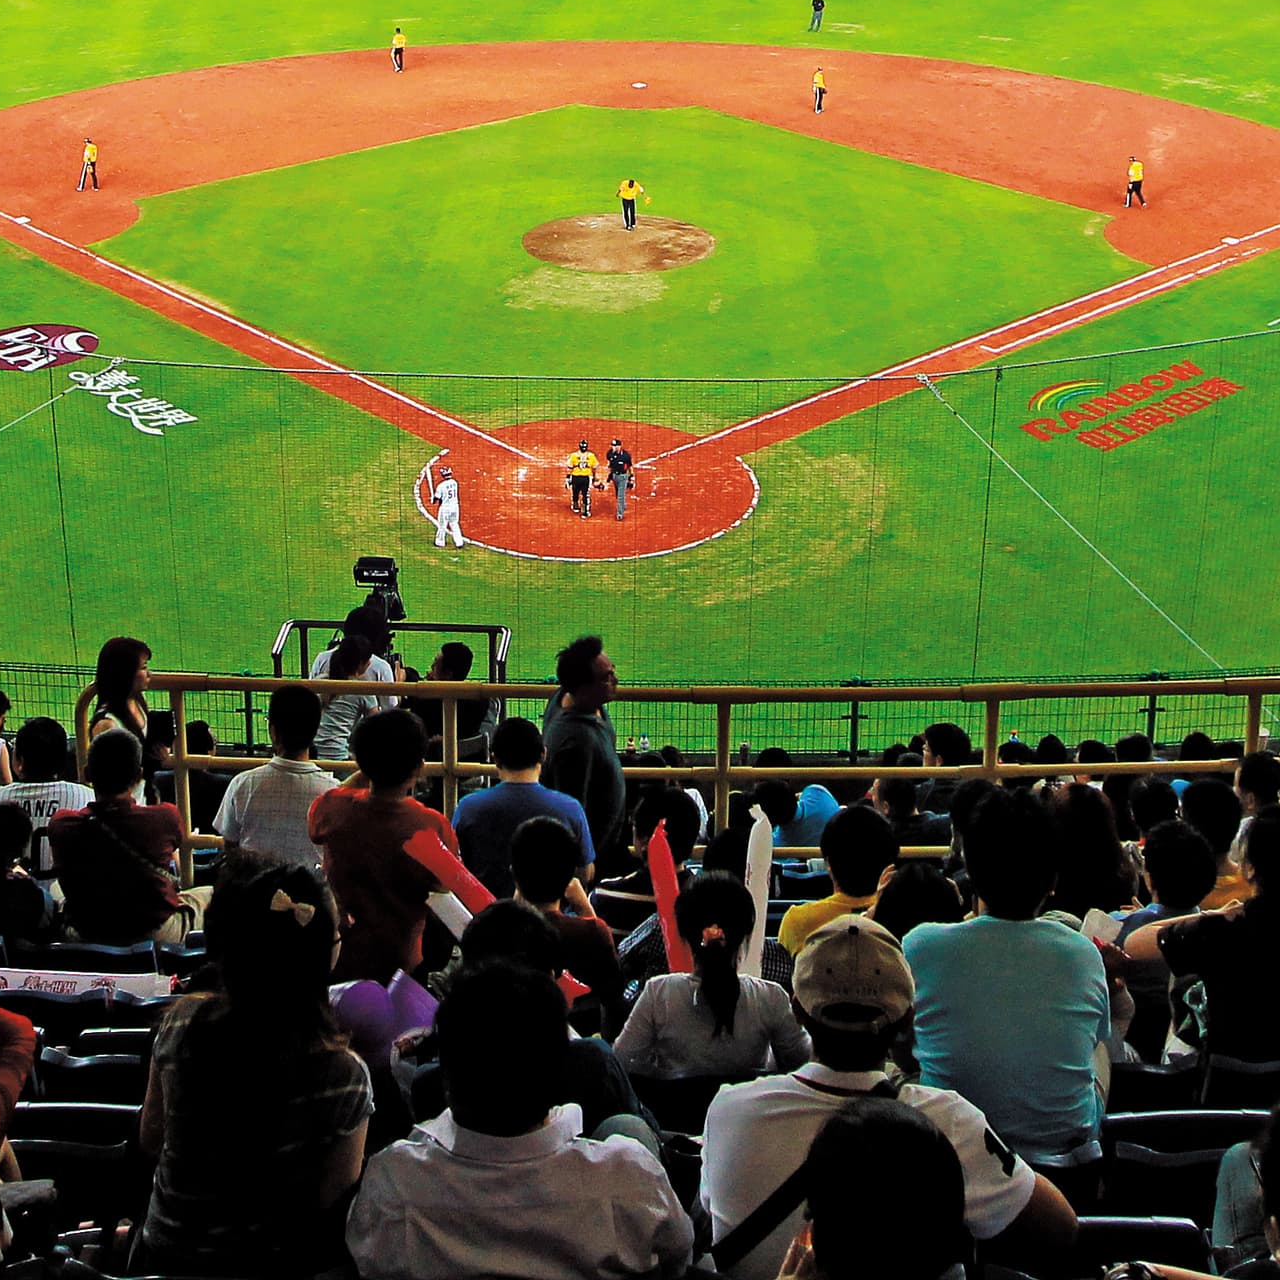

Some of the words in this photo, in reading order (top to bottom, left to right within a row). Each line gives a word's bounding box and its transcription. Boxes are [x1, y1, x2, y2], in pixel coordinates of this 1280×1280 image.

[1020, 360, 1205, 441] RAINBOW
[1076, 376, 1246, 452] 虹牌油漆
[15, 799, 60, 818] ANG
